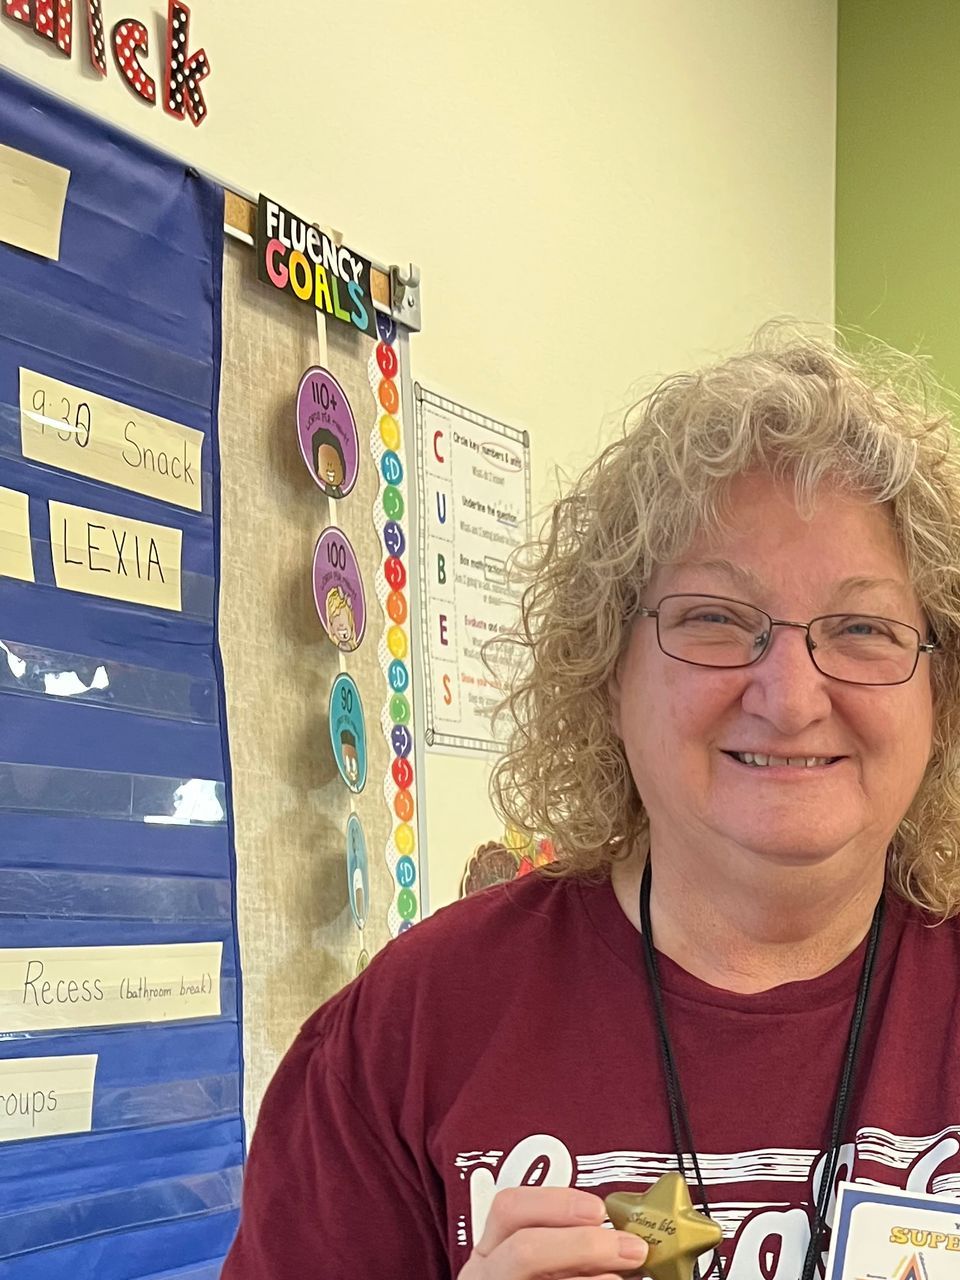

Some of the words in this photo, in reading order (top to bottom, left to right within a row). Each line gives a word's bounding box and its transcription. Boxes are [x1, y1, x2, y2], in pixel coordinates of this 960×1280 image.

[265, 238, 369, 330] GOALS
[312, 381, 337, 411] 110+
[122, 420, 194, 485] Snack
[64, 518, 165, 583] LEXIA
[327, 541, 346, 571] 100
[22, 960, 104, 1006] Recess
[120, 977, 172, 1000] (bathroom
[179, 973, 213, 997] break)
[658, 1218, 677, 1235] like
